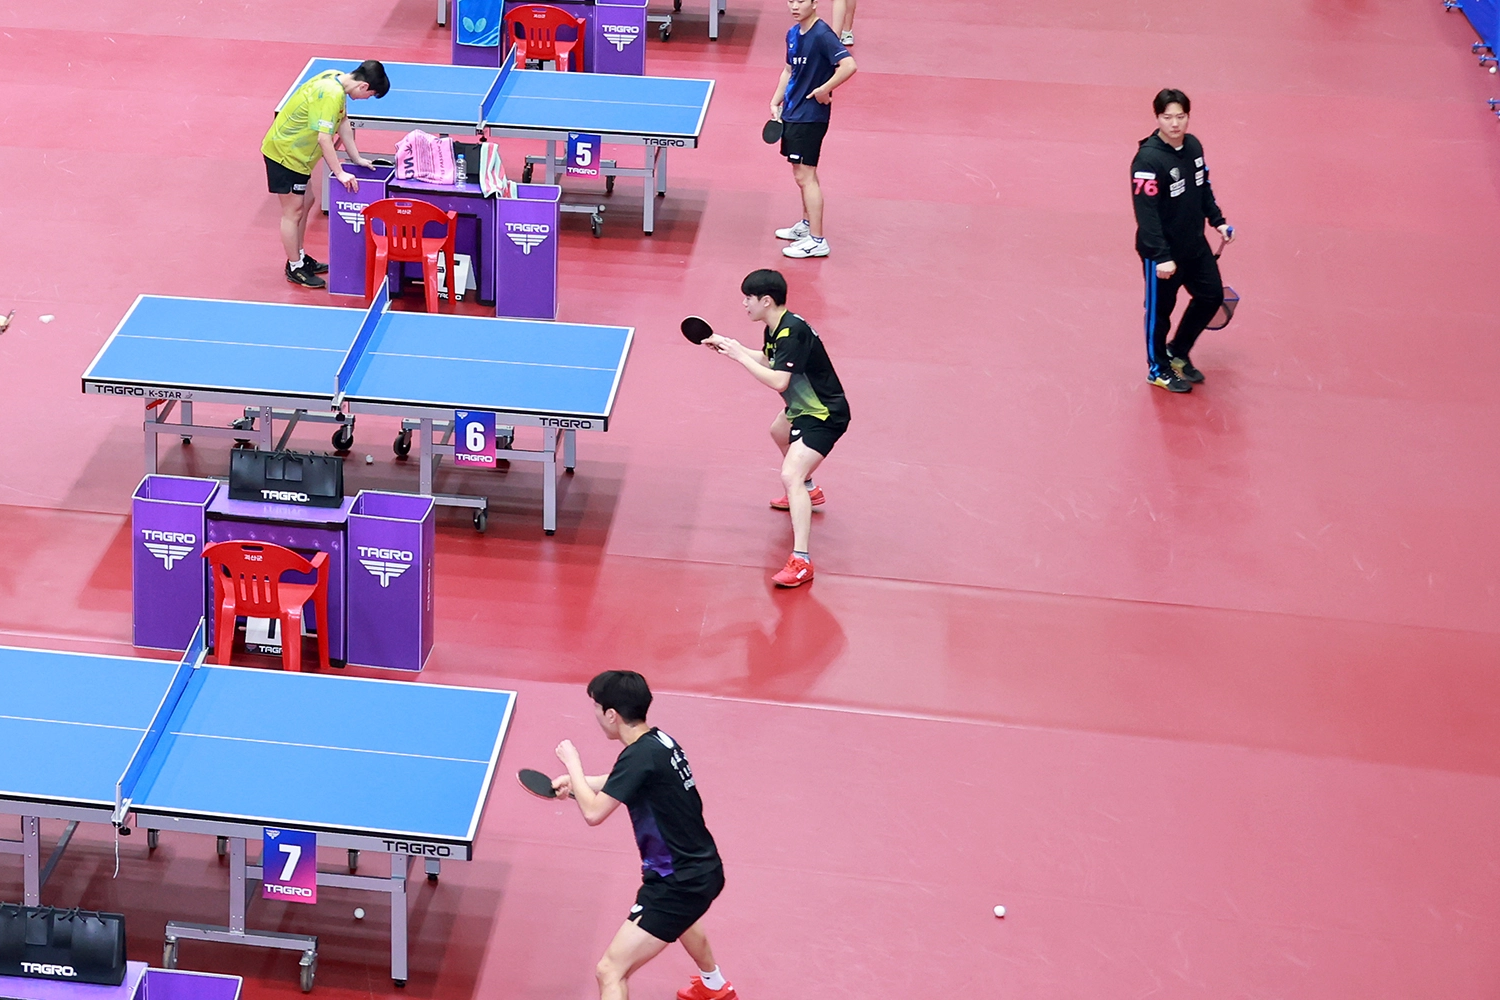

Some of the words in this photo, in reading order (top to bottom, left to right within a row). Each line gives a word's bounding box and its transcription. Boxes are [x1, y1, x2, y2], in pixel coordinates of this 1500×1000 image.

[602, 25, 639, 34] TAGRO
[642, 138, 685, 147] TAGRO
[575, 143, 592, 167] 5
[567, 166, 597, 175] TAGRO
[1133, 179, 1159, 197] 76
[505, 222, 549, 233] TAGRO
[95, 384, 143, 397] TAGRO
[148, 388, 182, 399] K-STAR
[538, 417, 592, 430] TAGRO
[465, 421, 485, 450] 6
[456, 453, 494, 464] TAGRO
[261, 490, 310, 503] TAGRO
[141, 529, 196, 544] TAGRO
[244, 554, 263, 562] 괴산군
[357, 546, 413, 561] TAGRO
[382, 839, 452, 857] TAGRO
[278, 843, 302, 882] 7
[264, 883, 313, 897] TAGRO
[21, 962, 77, 977] TAGRO
